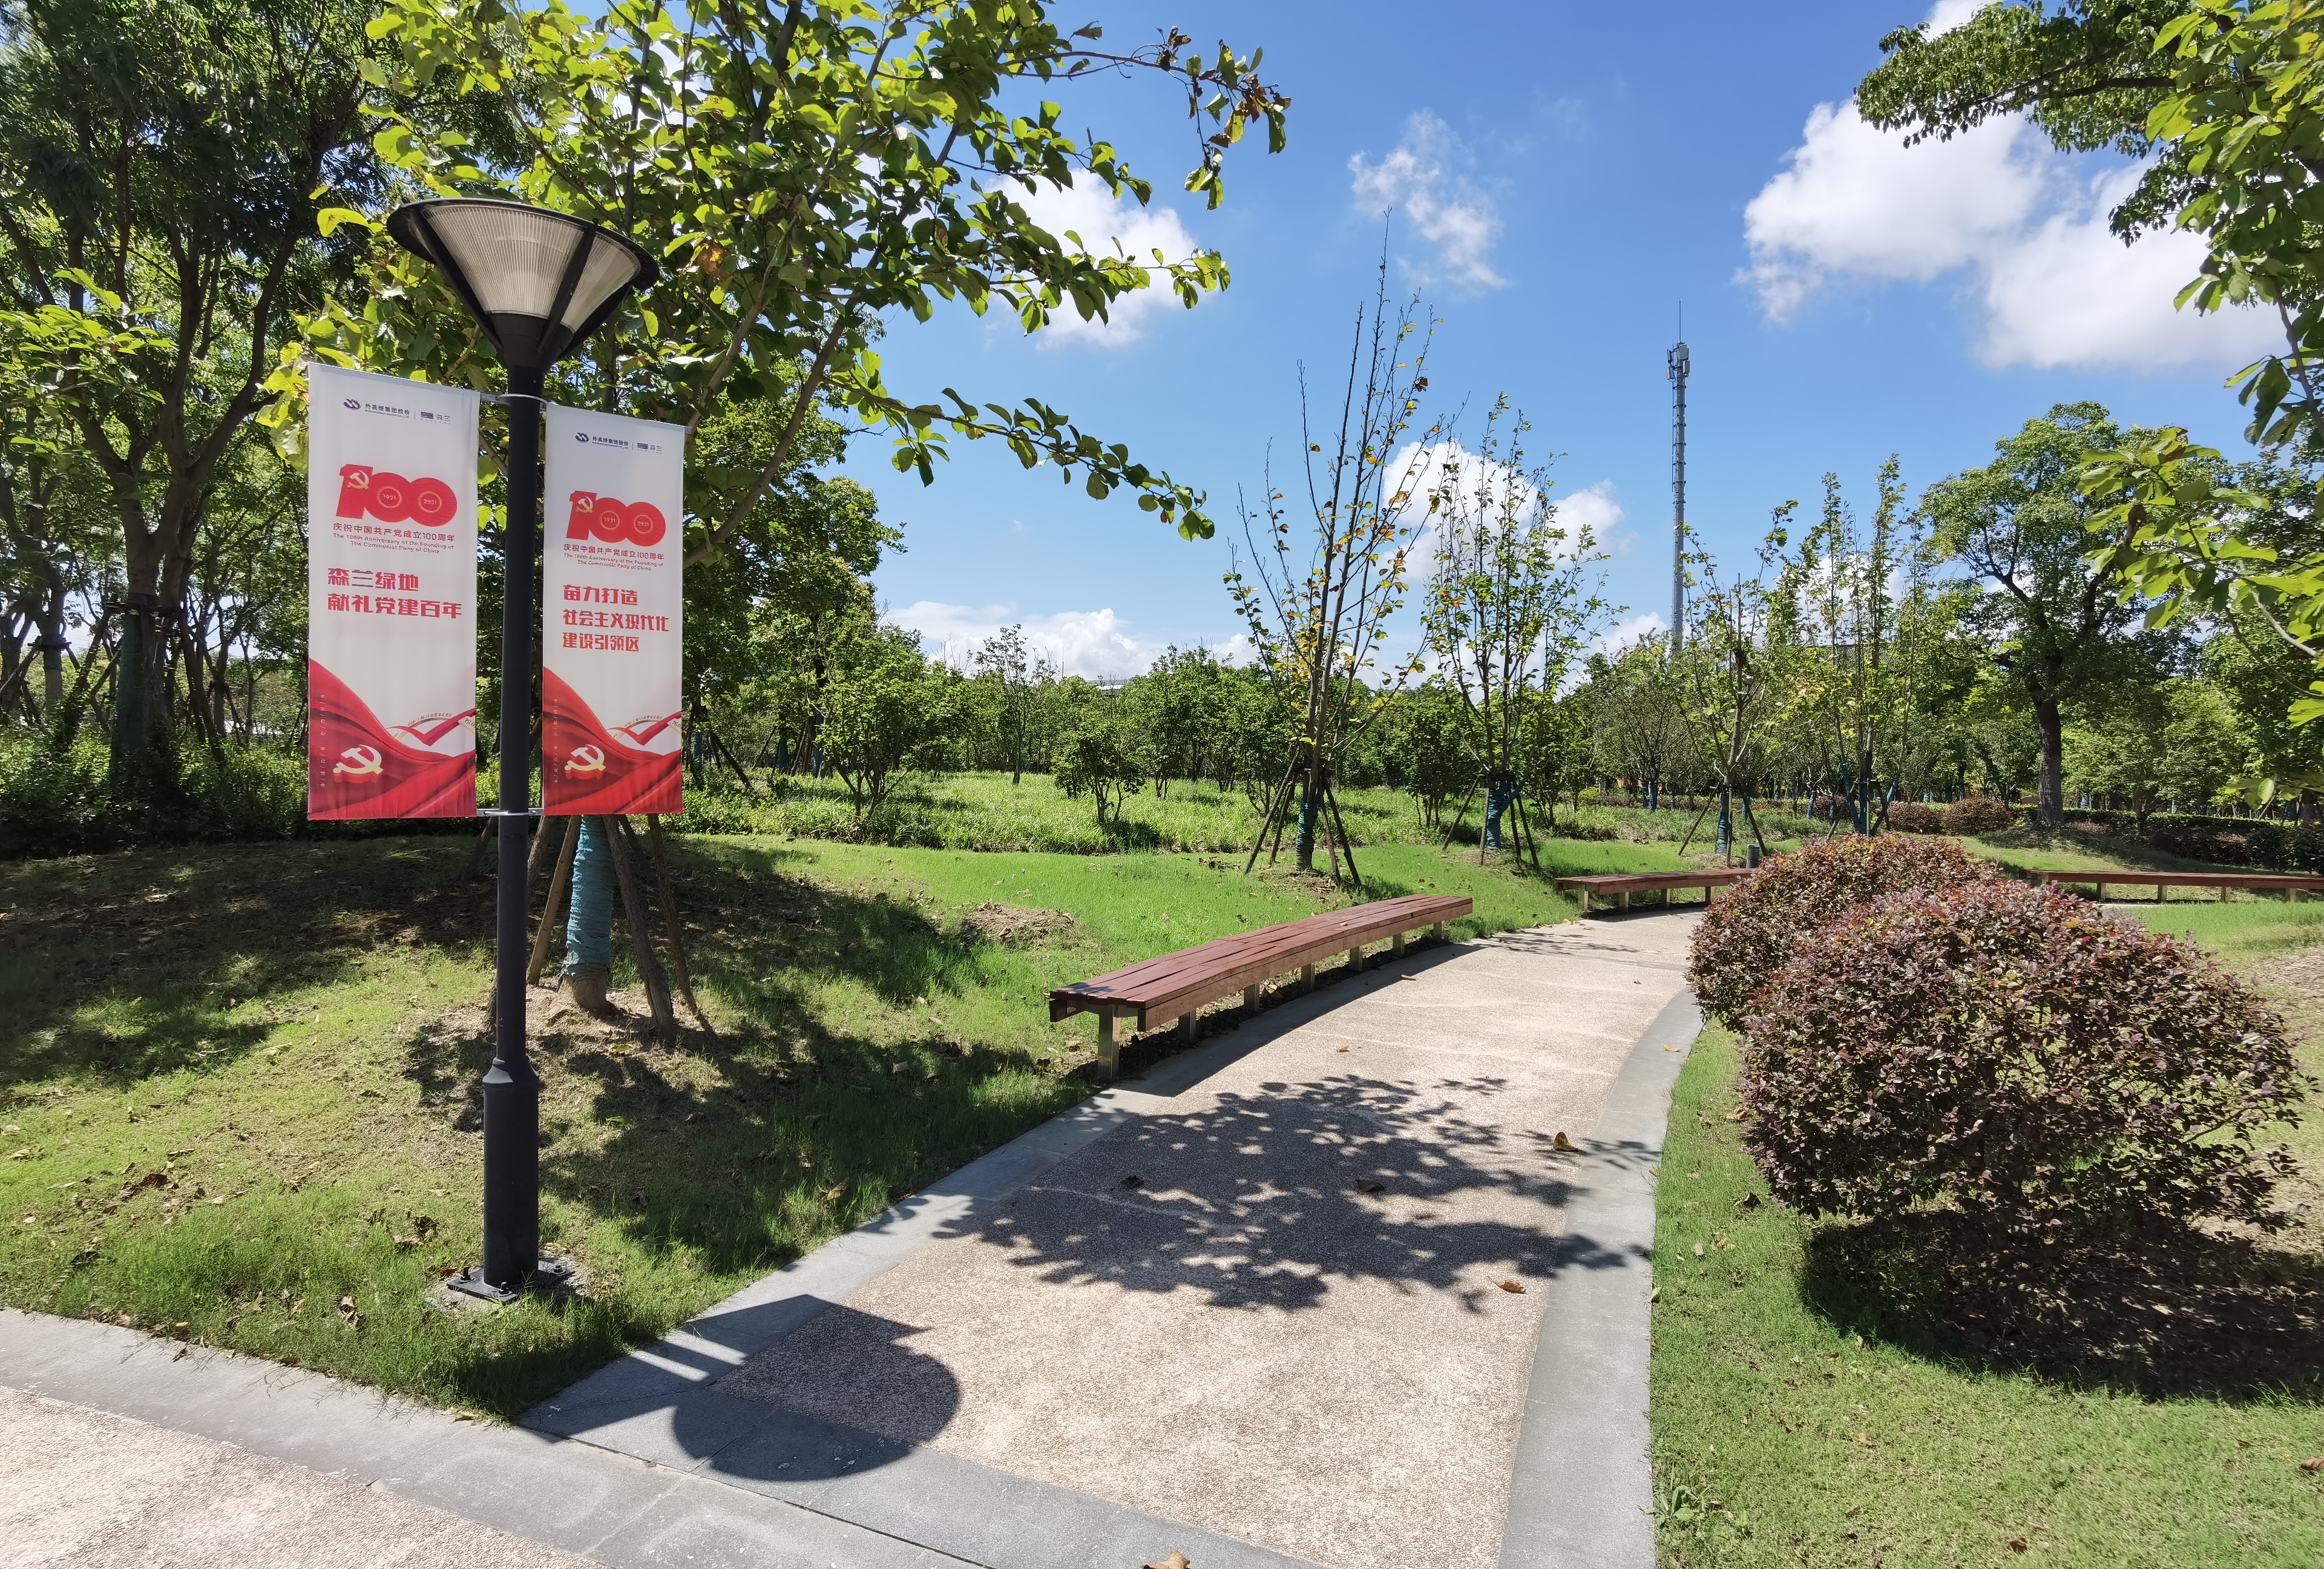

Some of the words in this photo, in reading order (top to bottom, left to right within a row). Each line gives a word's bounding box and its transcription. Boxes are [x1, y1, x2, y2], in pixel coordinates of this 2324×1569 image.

[333, 523, 455, 542] 庆祝中国共产党成立100周年
[563, 544, 665, 560] 庆祝中国共产党成立100周年
[327, 568, 419, 591] 森兰绿地
[327, 593, 462, 619] 献礼党建百年
[563, 584, 638, 606] 奋力打造
[562, 609, 669, 632] 社会主义现代化
[562, 632, 640, 652] 建设引领区
